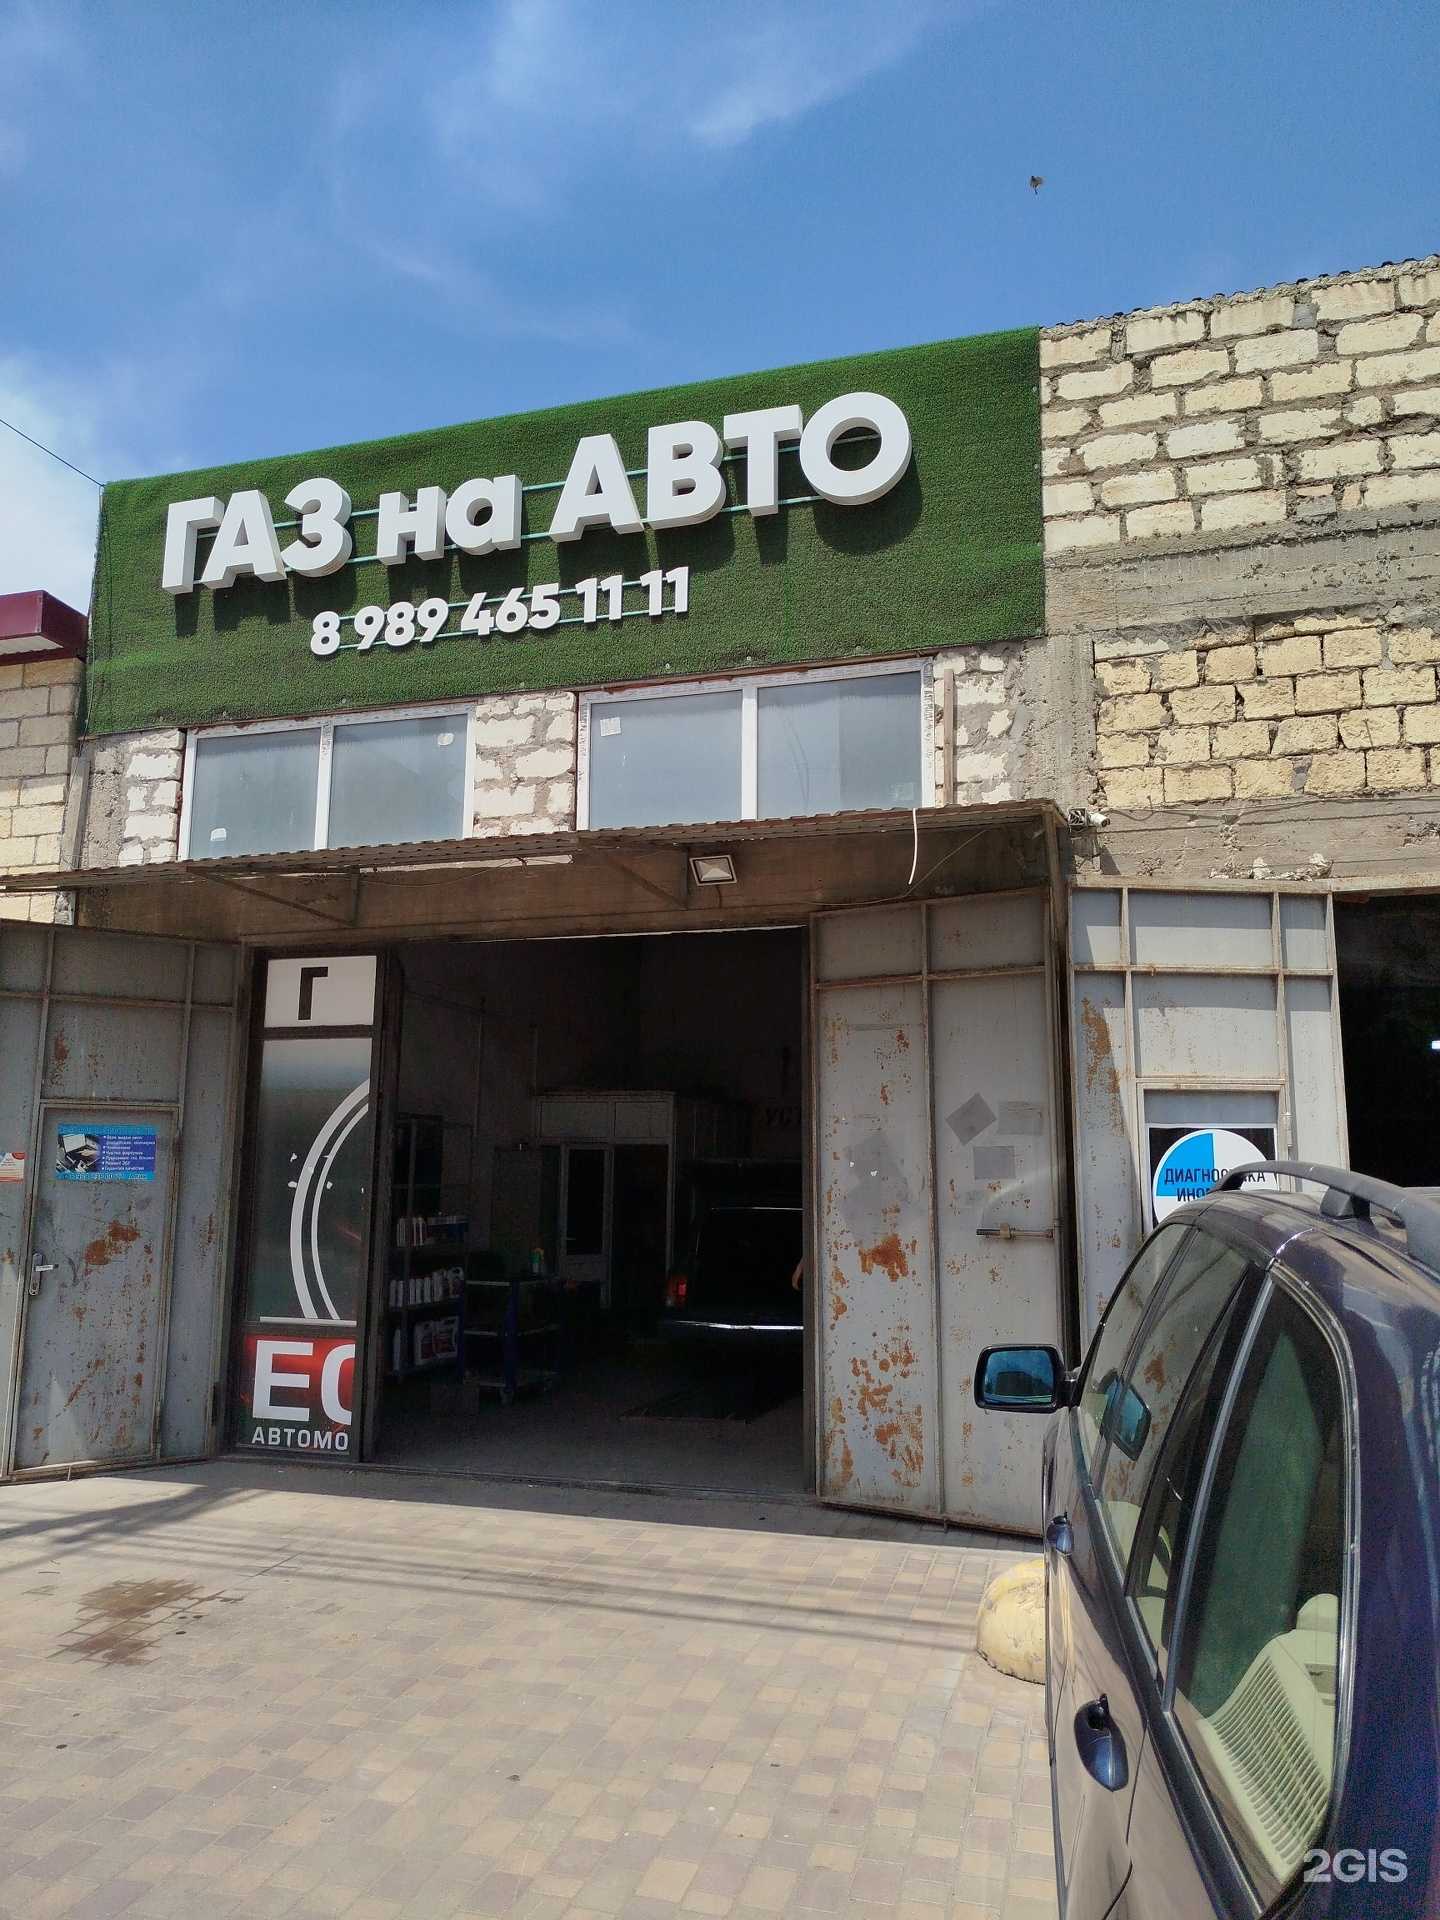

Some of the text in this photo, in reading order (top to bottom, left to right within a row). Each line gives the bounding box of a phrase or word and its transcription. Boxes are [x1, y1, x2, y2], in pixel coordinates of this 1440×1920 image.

[162, 392, 912, 594] ГАЗ на АВТО
[310, 566, 689, 655] 8 989 465 11 11
[251, 1426, 349, 1451] АВТОМО
